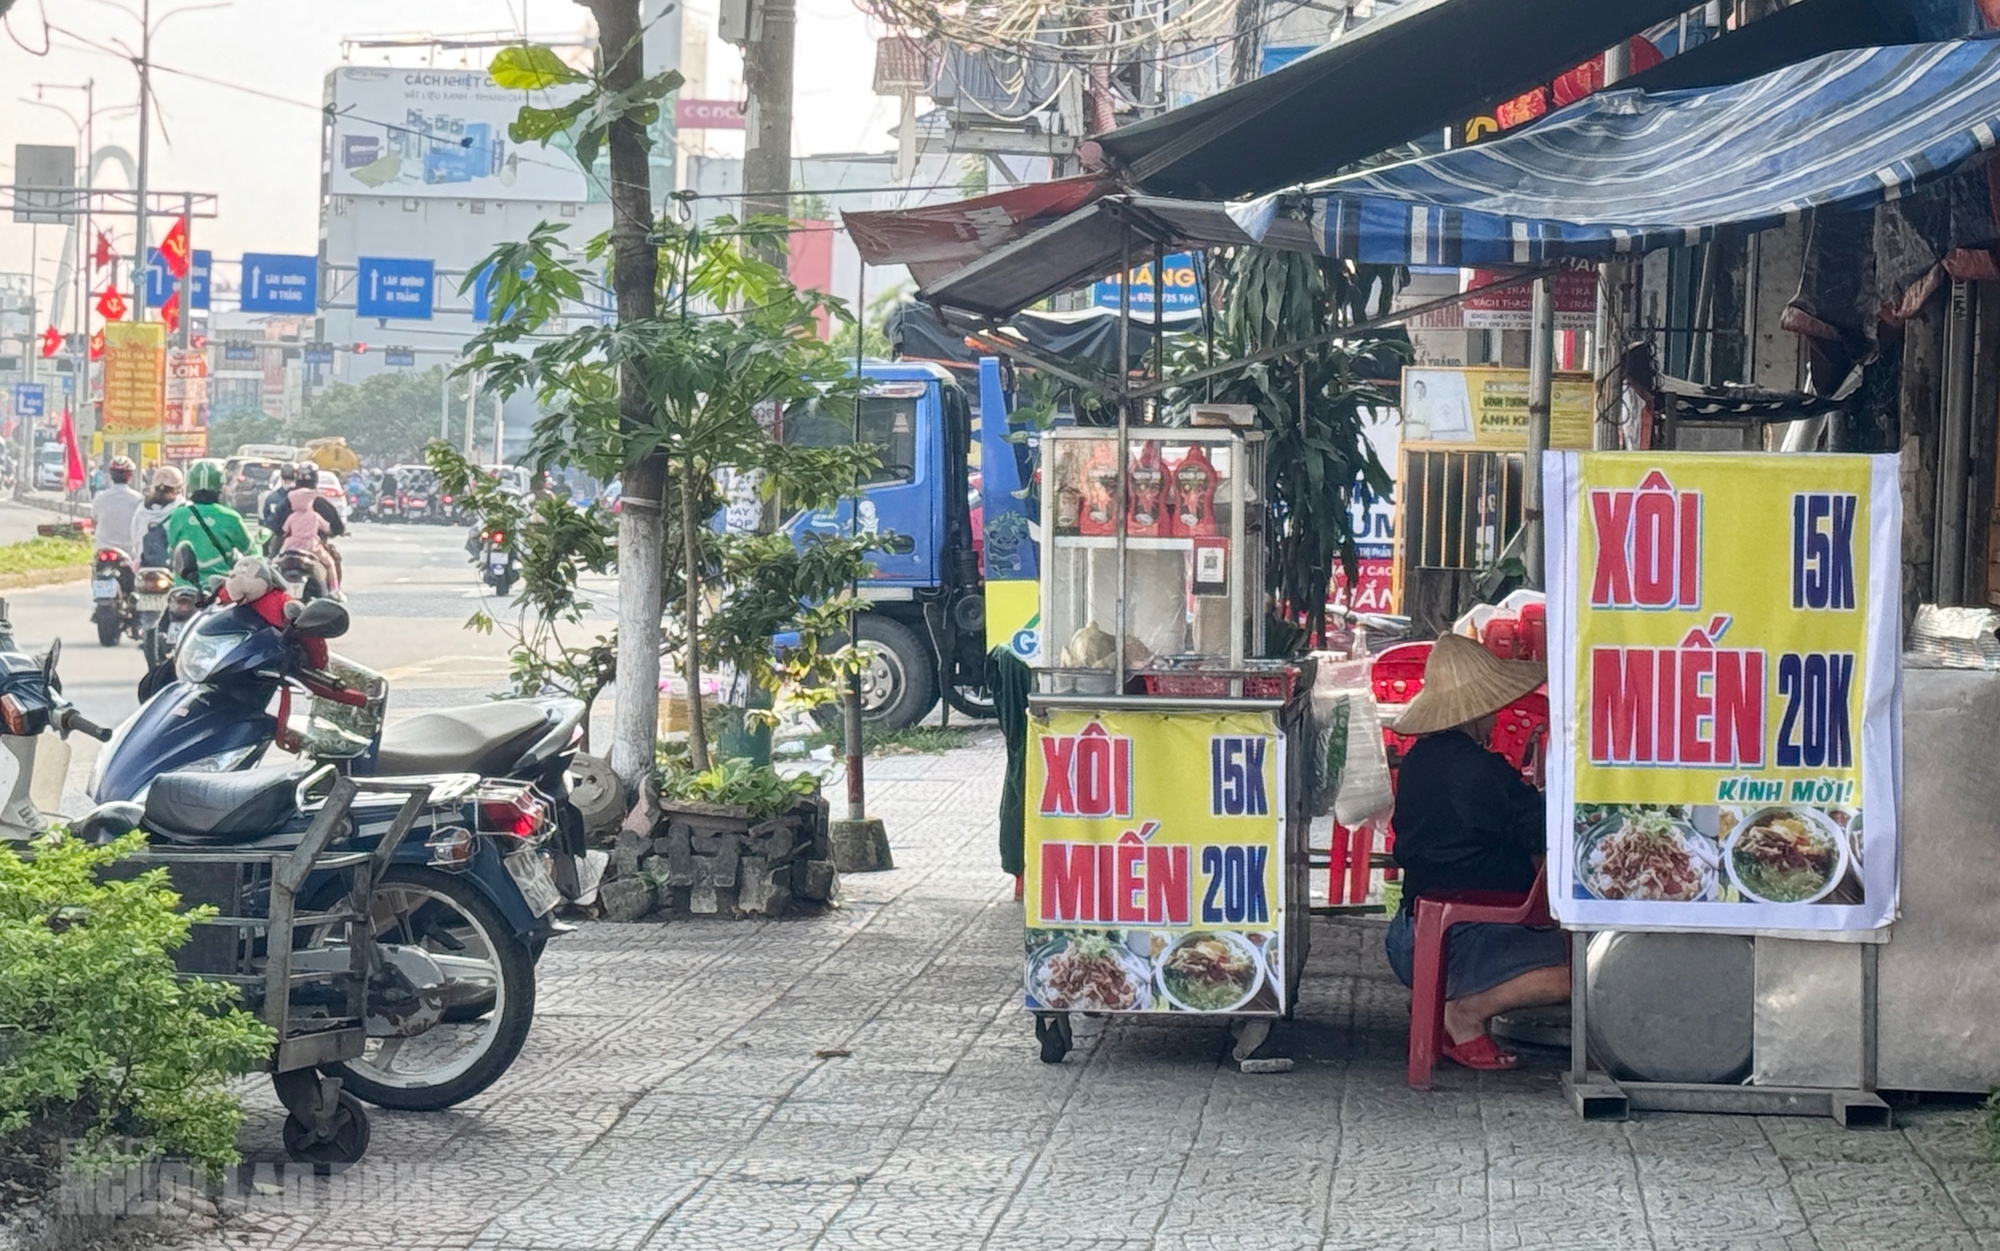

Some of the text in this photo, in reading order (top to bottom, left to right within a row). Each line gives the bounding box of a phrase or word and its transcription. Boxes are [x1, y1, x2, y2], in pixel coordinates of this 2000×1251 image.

[405, 74, 440, 87] CÁCH
[1590, 469, 1858, 610] XÔI 15K
[1590, 613, 1854, 770] MIẾN 20K
[1040, 721, 1269, 818] XÔI 15K
[1718, 777, 1854, 802] KÍNH MỜI!
[1040, 821, 1270, 926] MIẾN 20K
